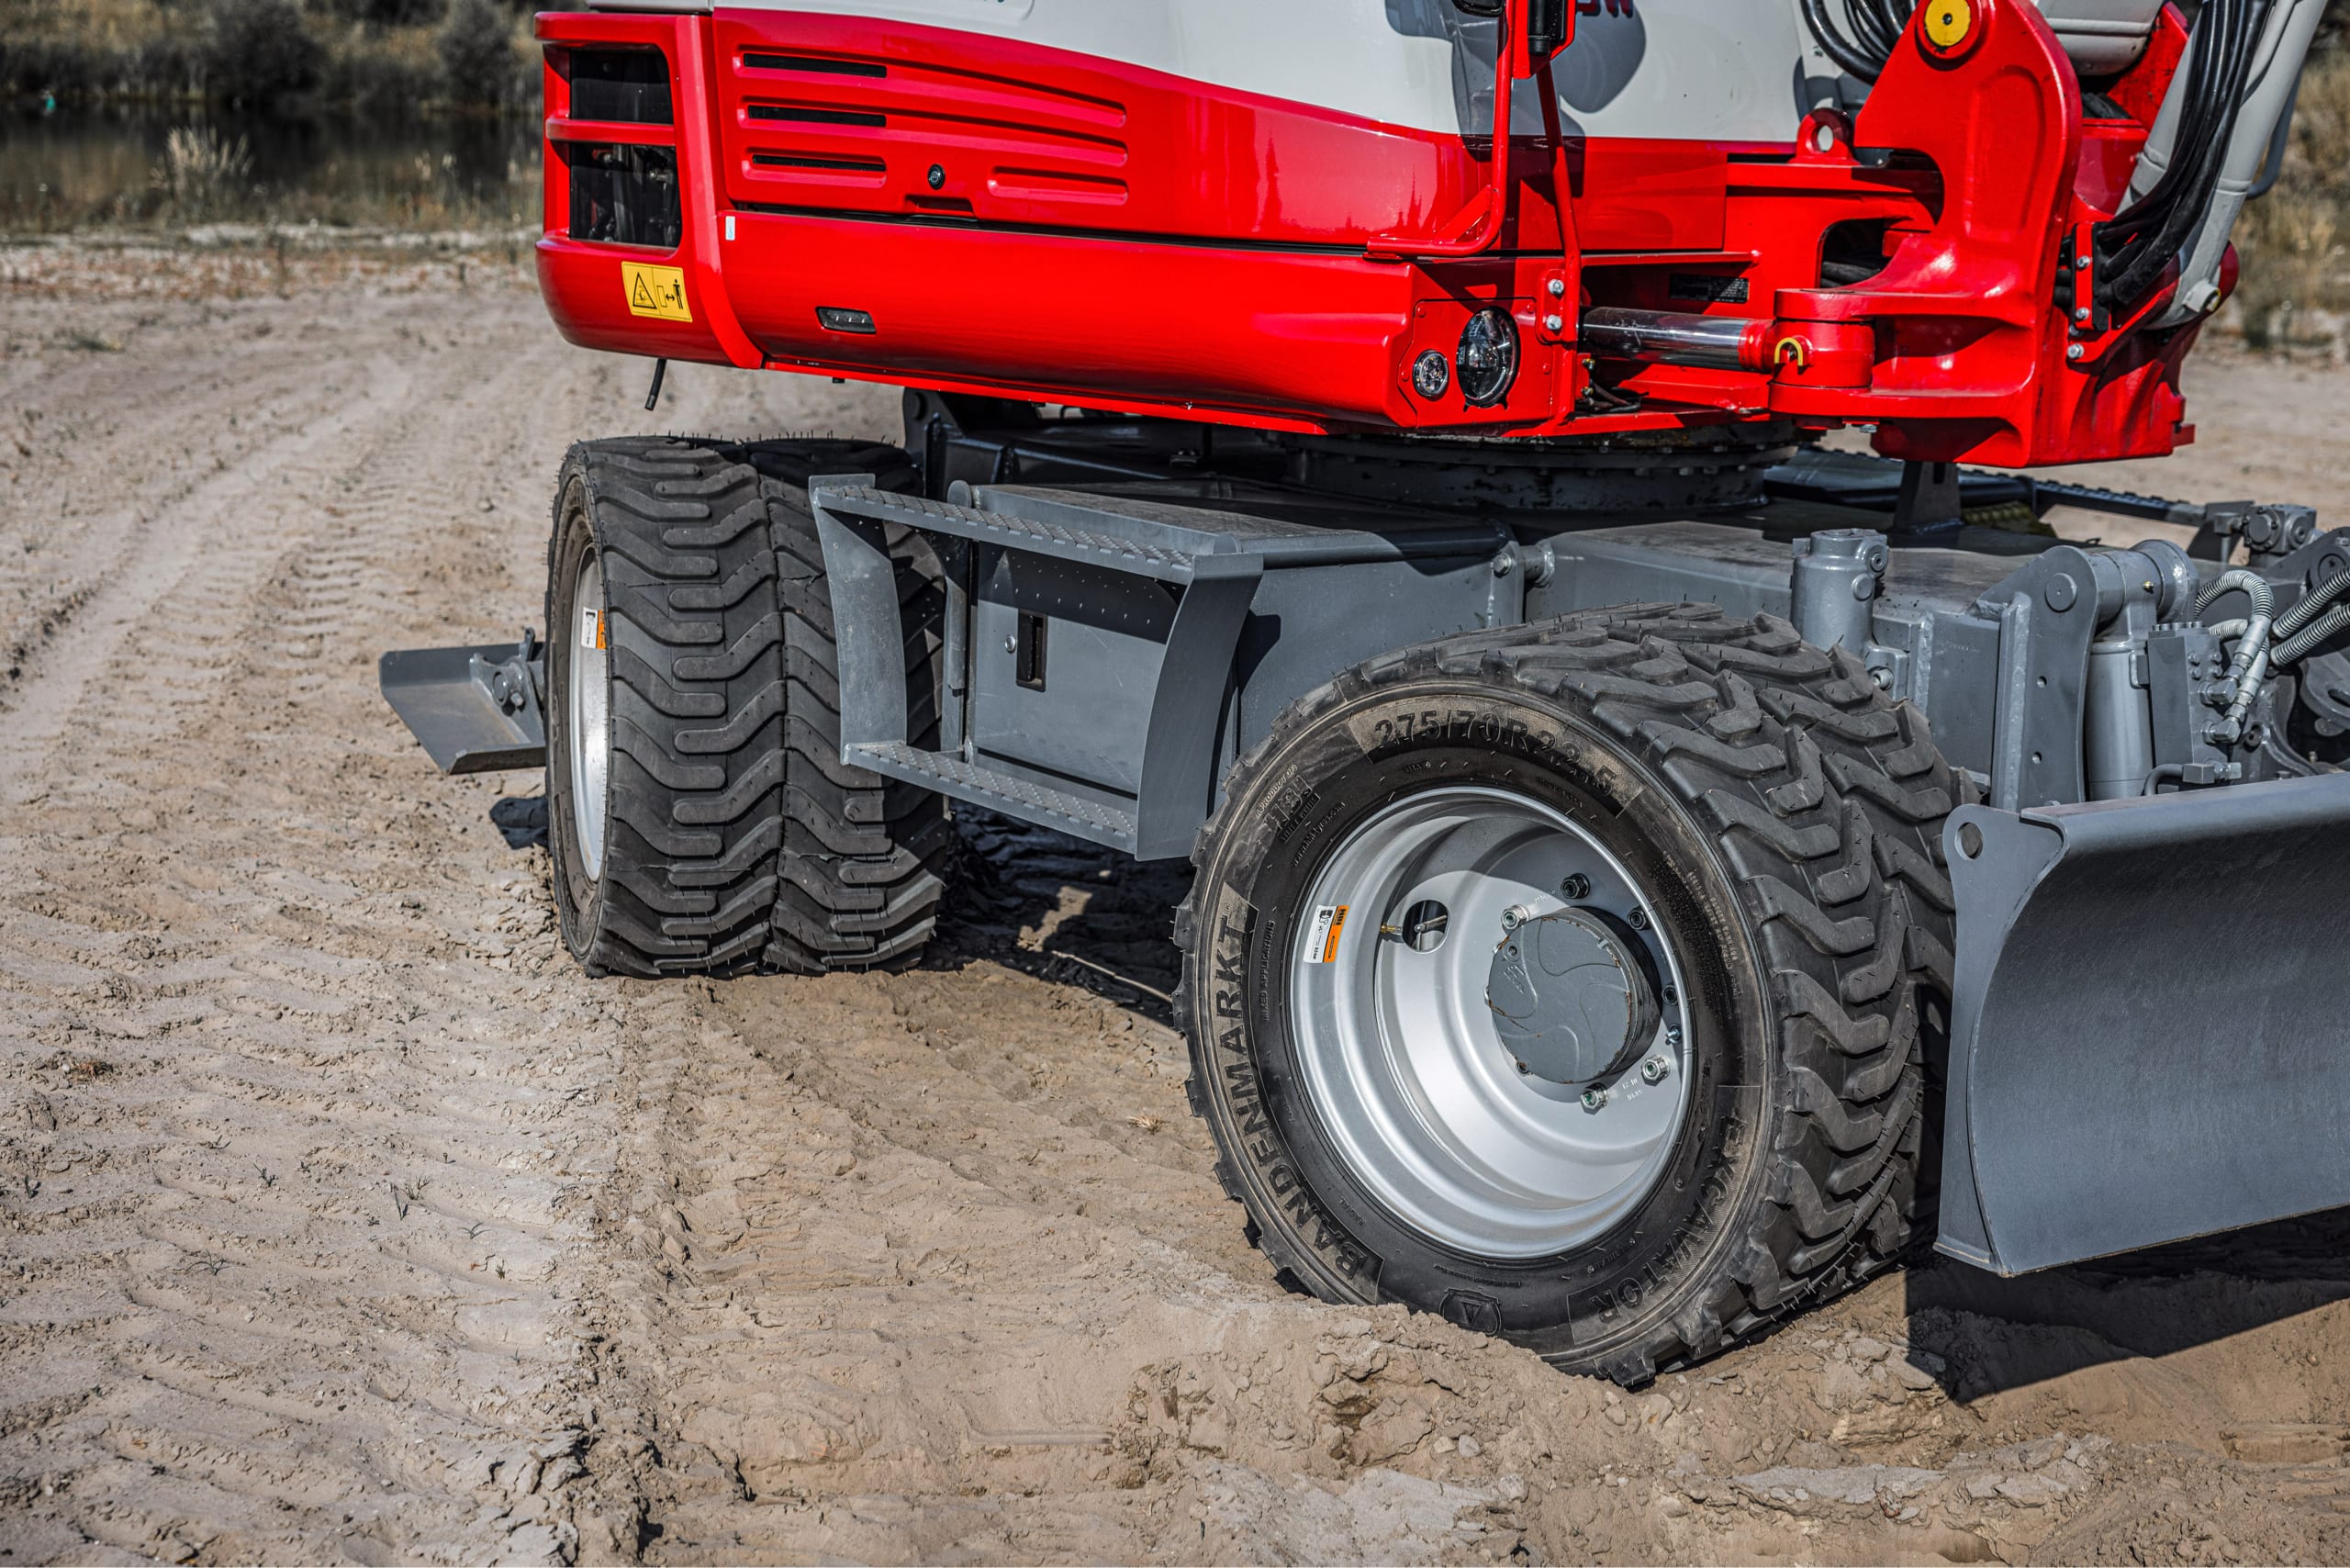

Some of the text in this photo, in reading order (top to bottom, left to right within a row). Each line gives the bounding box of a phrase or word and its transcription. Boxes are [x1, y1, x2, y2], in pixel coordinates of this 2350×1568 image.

[1259, 775, 1287, 812] PRODUCT
[1259, 920, 1275, 988] APPLICATIONS
[1215, 913, 1368, 1282] BANDENMARKT
[1589, 1115, 1748, 1323] EXCAVATOR
